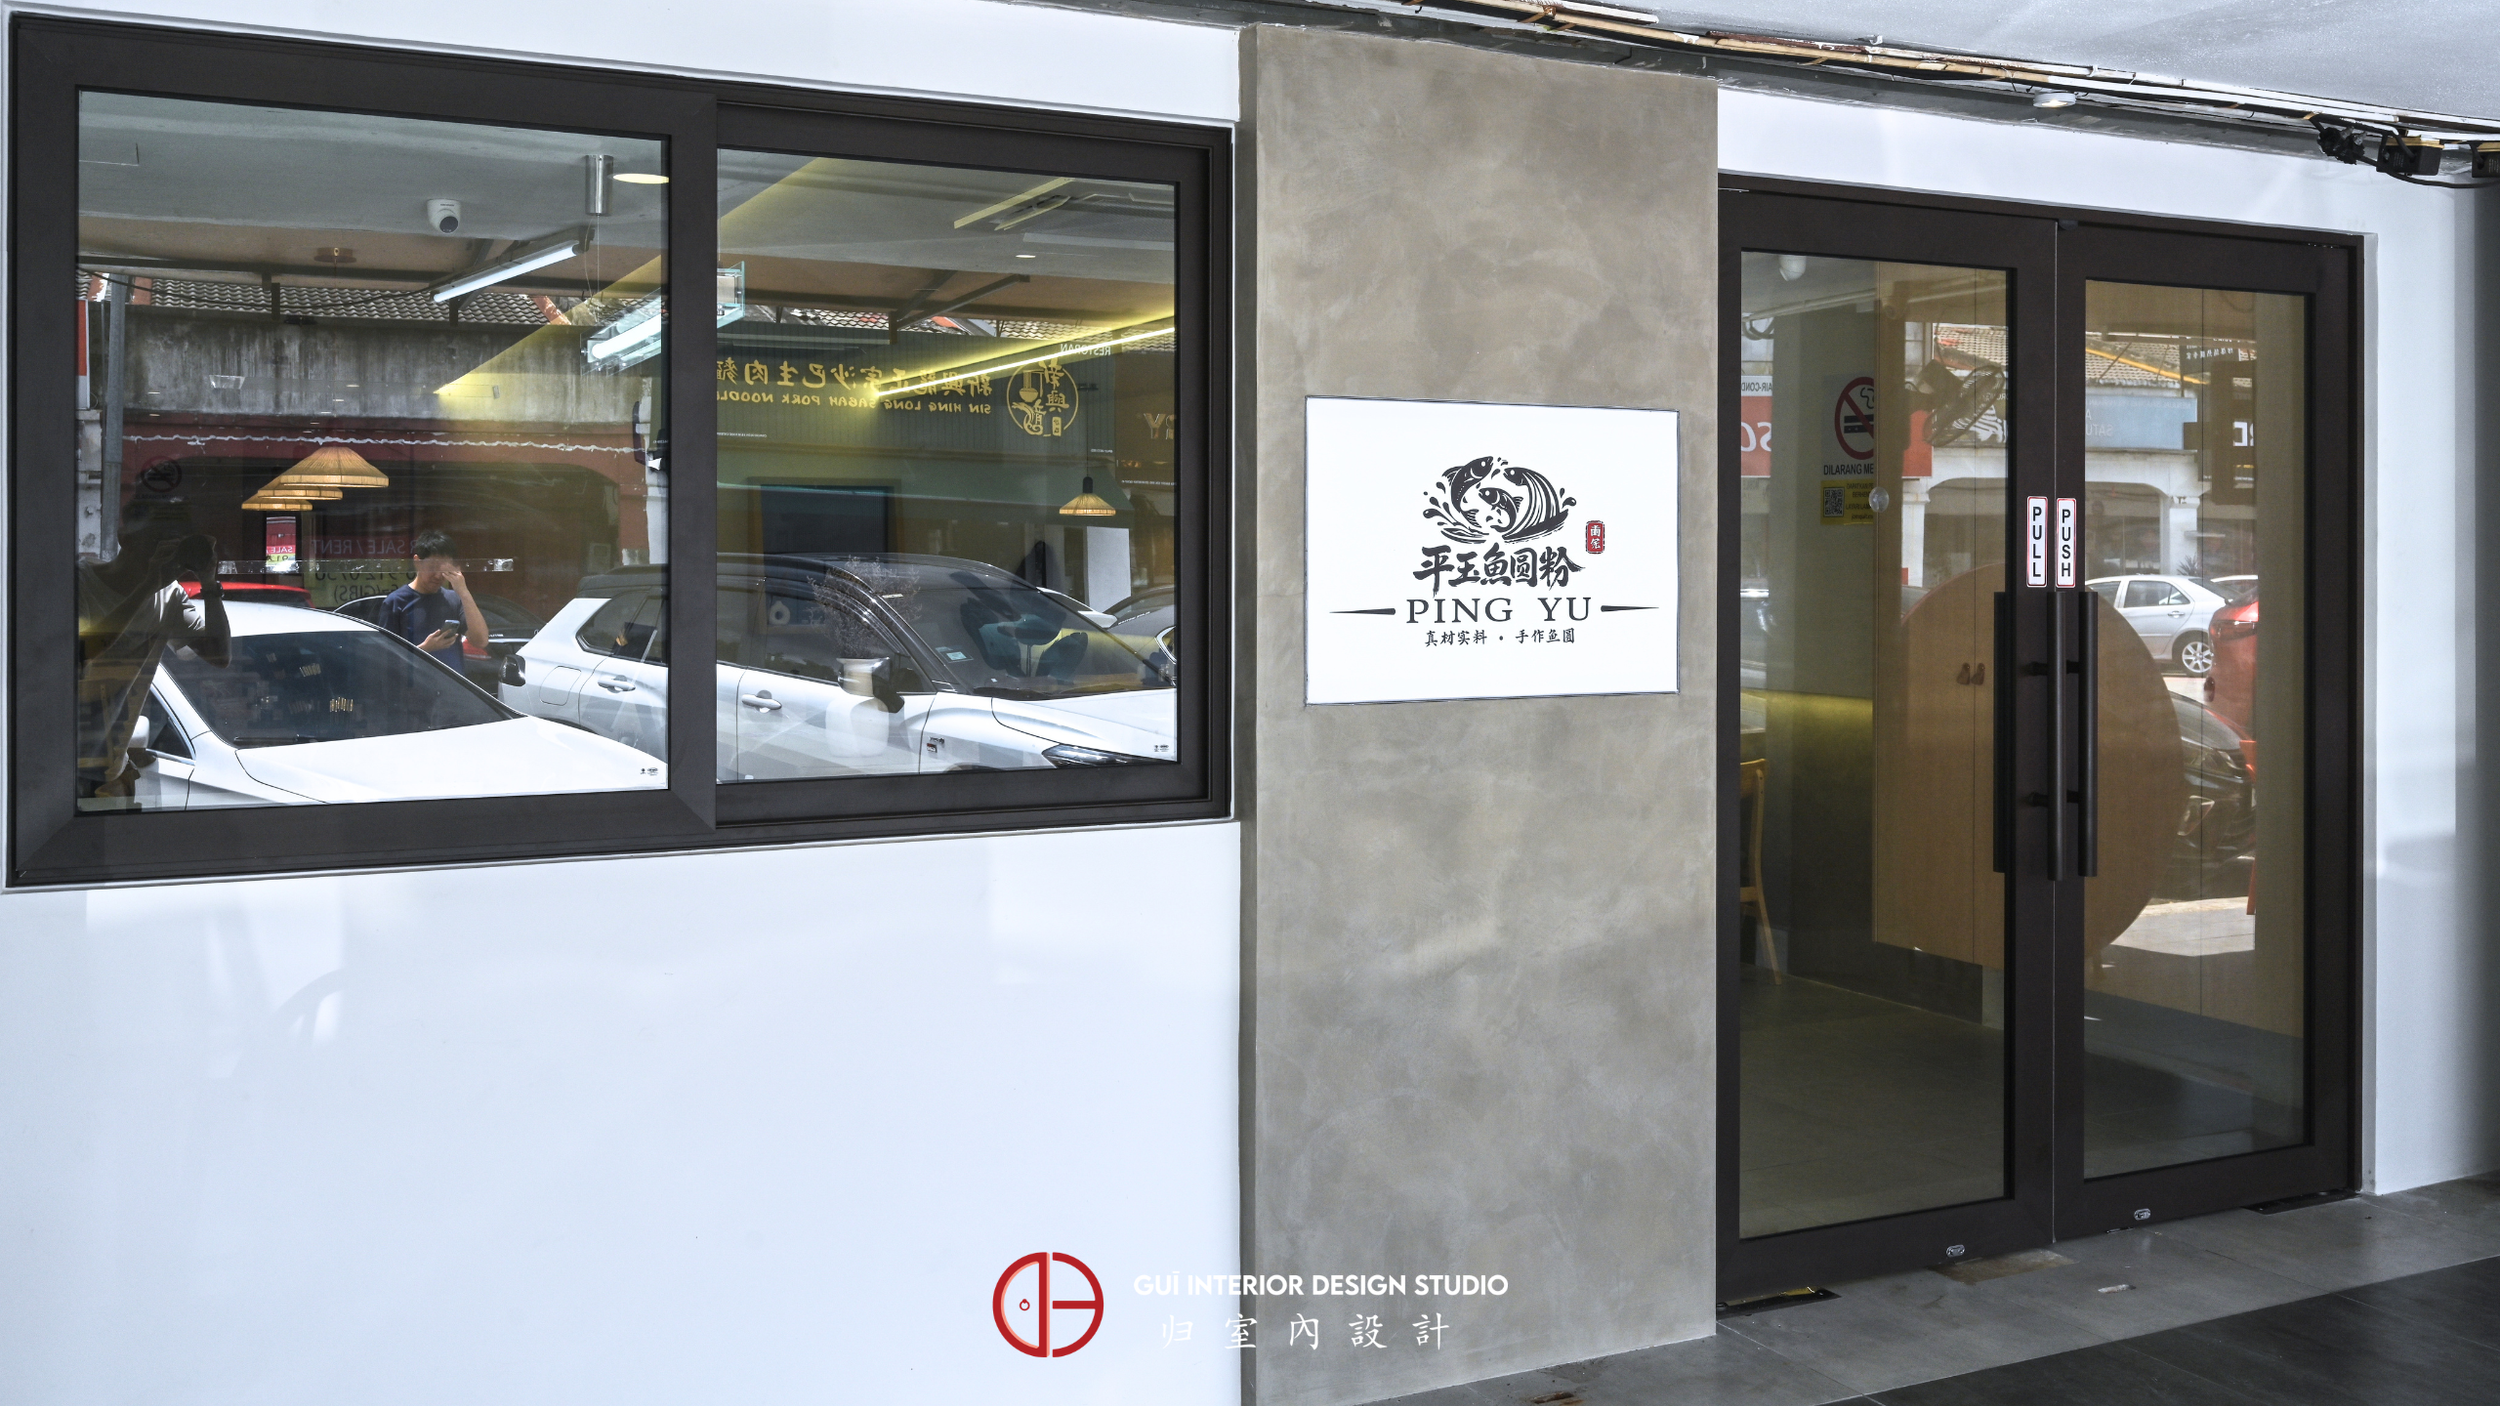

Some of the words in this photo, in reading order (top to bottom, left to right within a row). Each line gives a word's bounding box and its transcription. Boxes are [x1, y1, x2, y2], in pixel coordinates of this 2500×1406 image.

[1823, 463, 1862, 476] DILARANG
[2032, 506, 2043, 578] PULL
[2061, 508, 2071, 578] PUSH
[1406, 597, 1513, 624] PING
[1537, 596, 1592, 622] YU
[1425, 629, 1488, 648] 真材实料
